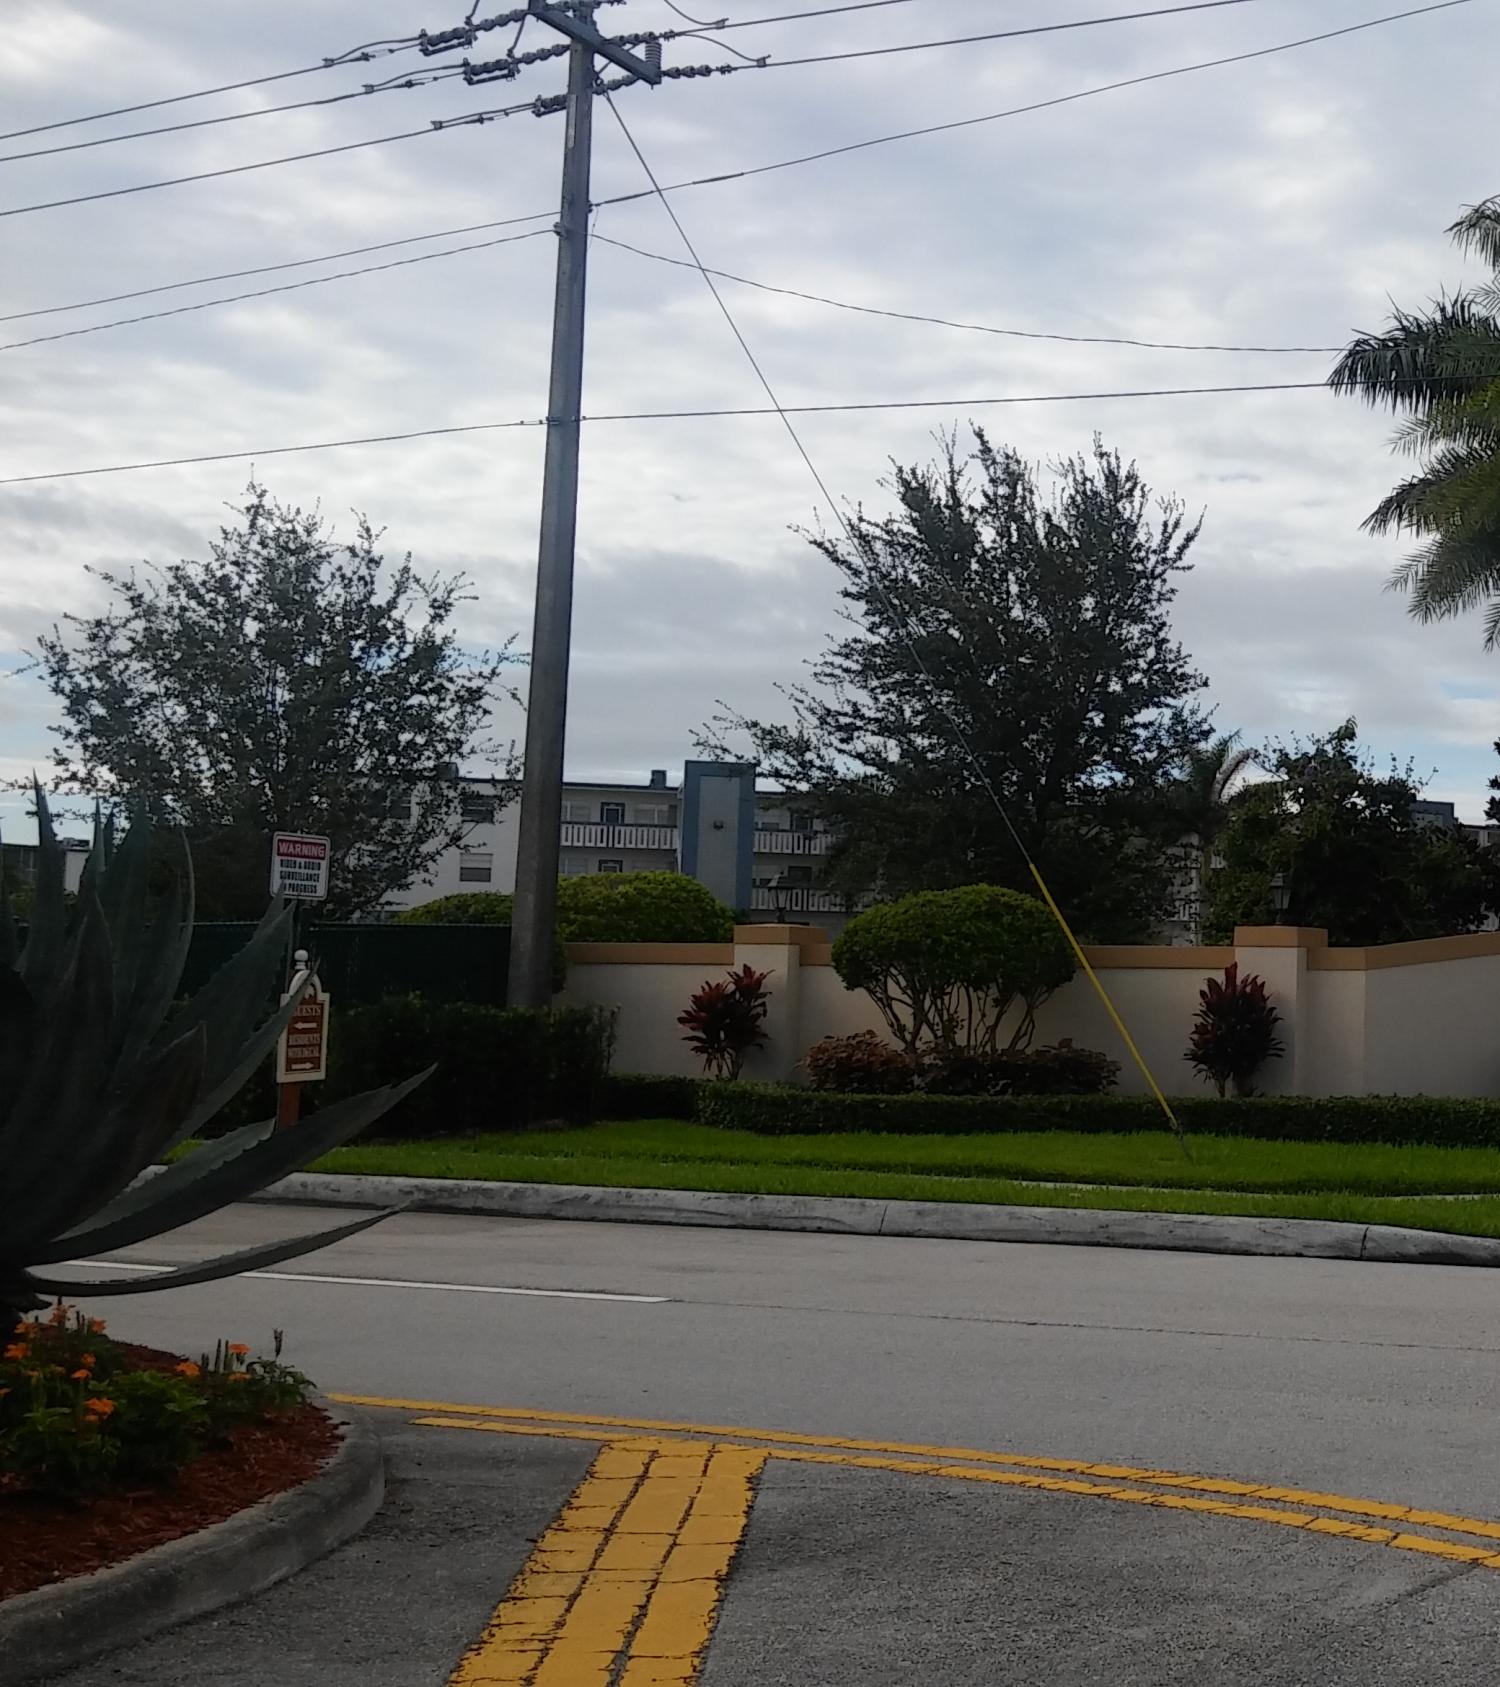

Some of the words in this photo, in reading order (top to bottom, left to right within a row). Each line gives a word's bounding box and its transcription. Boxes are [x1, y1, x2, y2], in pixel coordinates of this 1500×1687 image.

[278, 841, 325, 857] WARNING
[280, 870, 320, 883] SURVEILLANCE
[288, 883, 317, 894] PROGRESS
